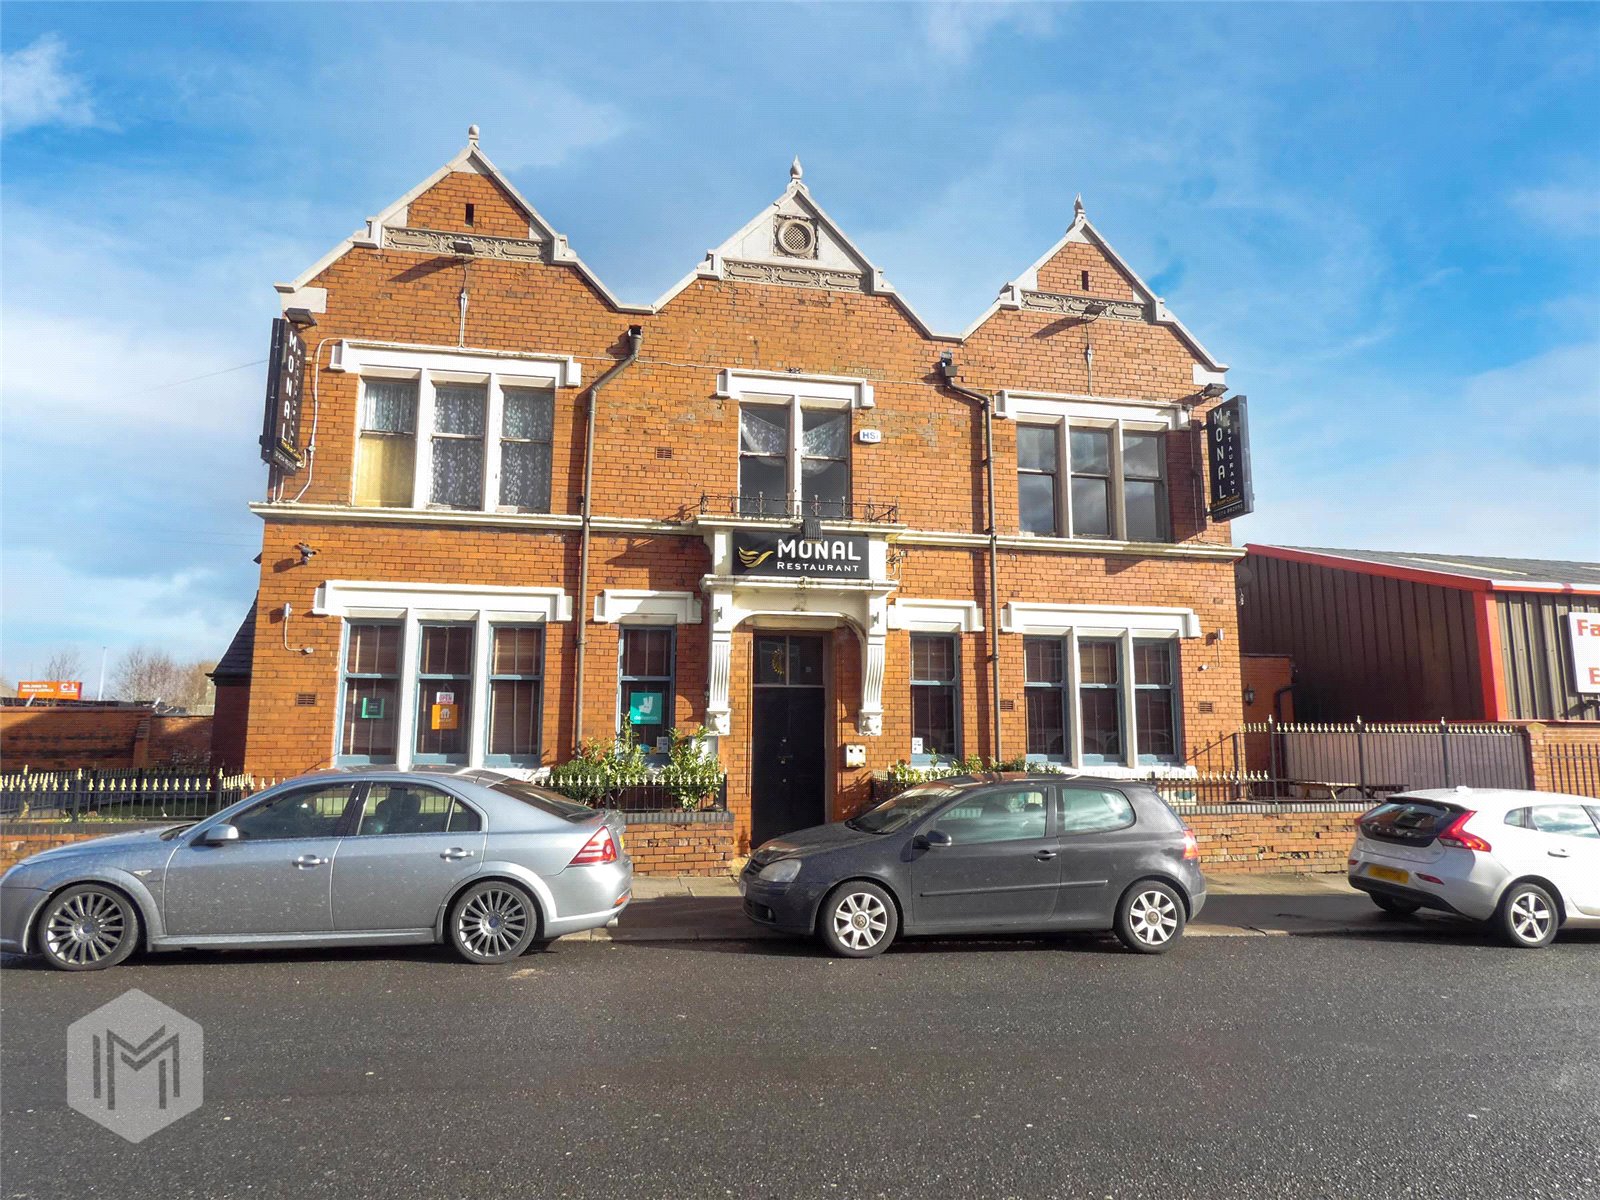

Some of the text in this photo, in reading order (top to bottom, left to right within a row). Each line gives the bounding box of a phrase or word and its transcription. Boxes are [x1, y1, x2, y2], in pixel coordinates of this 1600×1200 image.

[281, 331, 298, 443] MONAL
[1213, 407, 1227, 500] MONAL
[776, 561, 860, 573] RESTAURANT
[777, 538, 862, 561] MONAL
